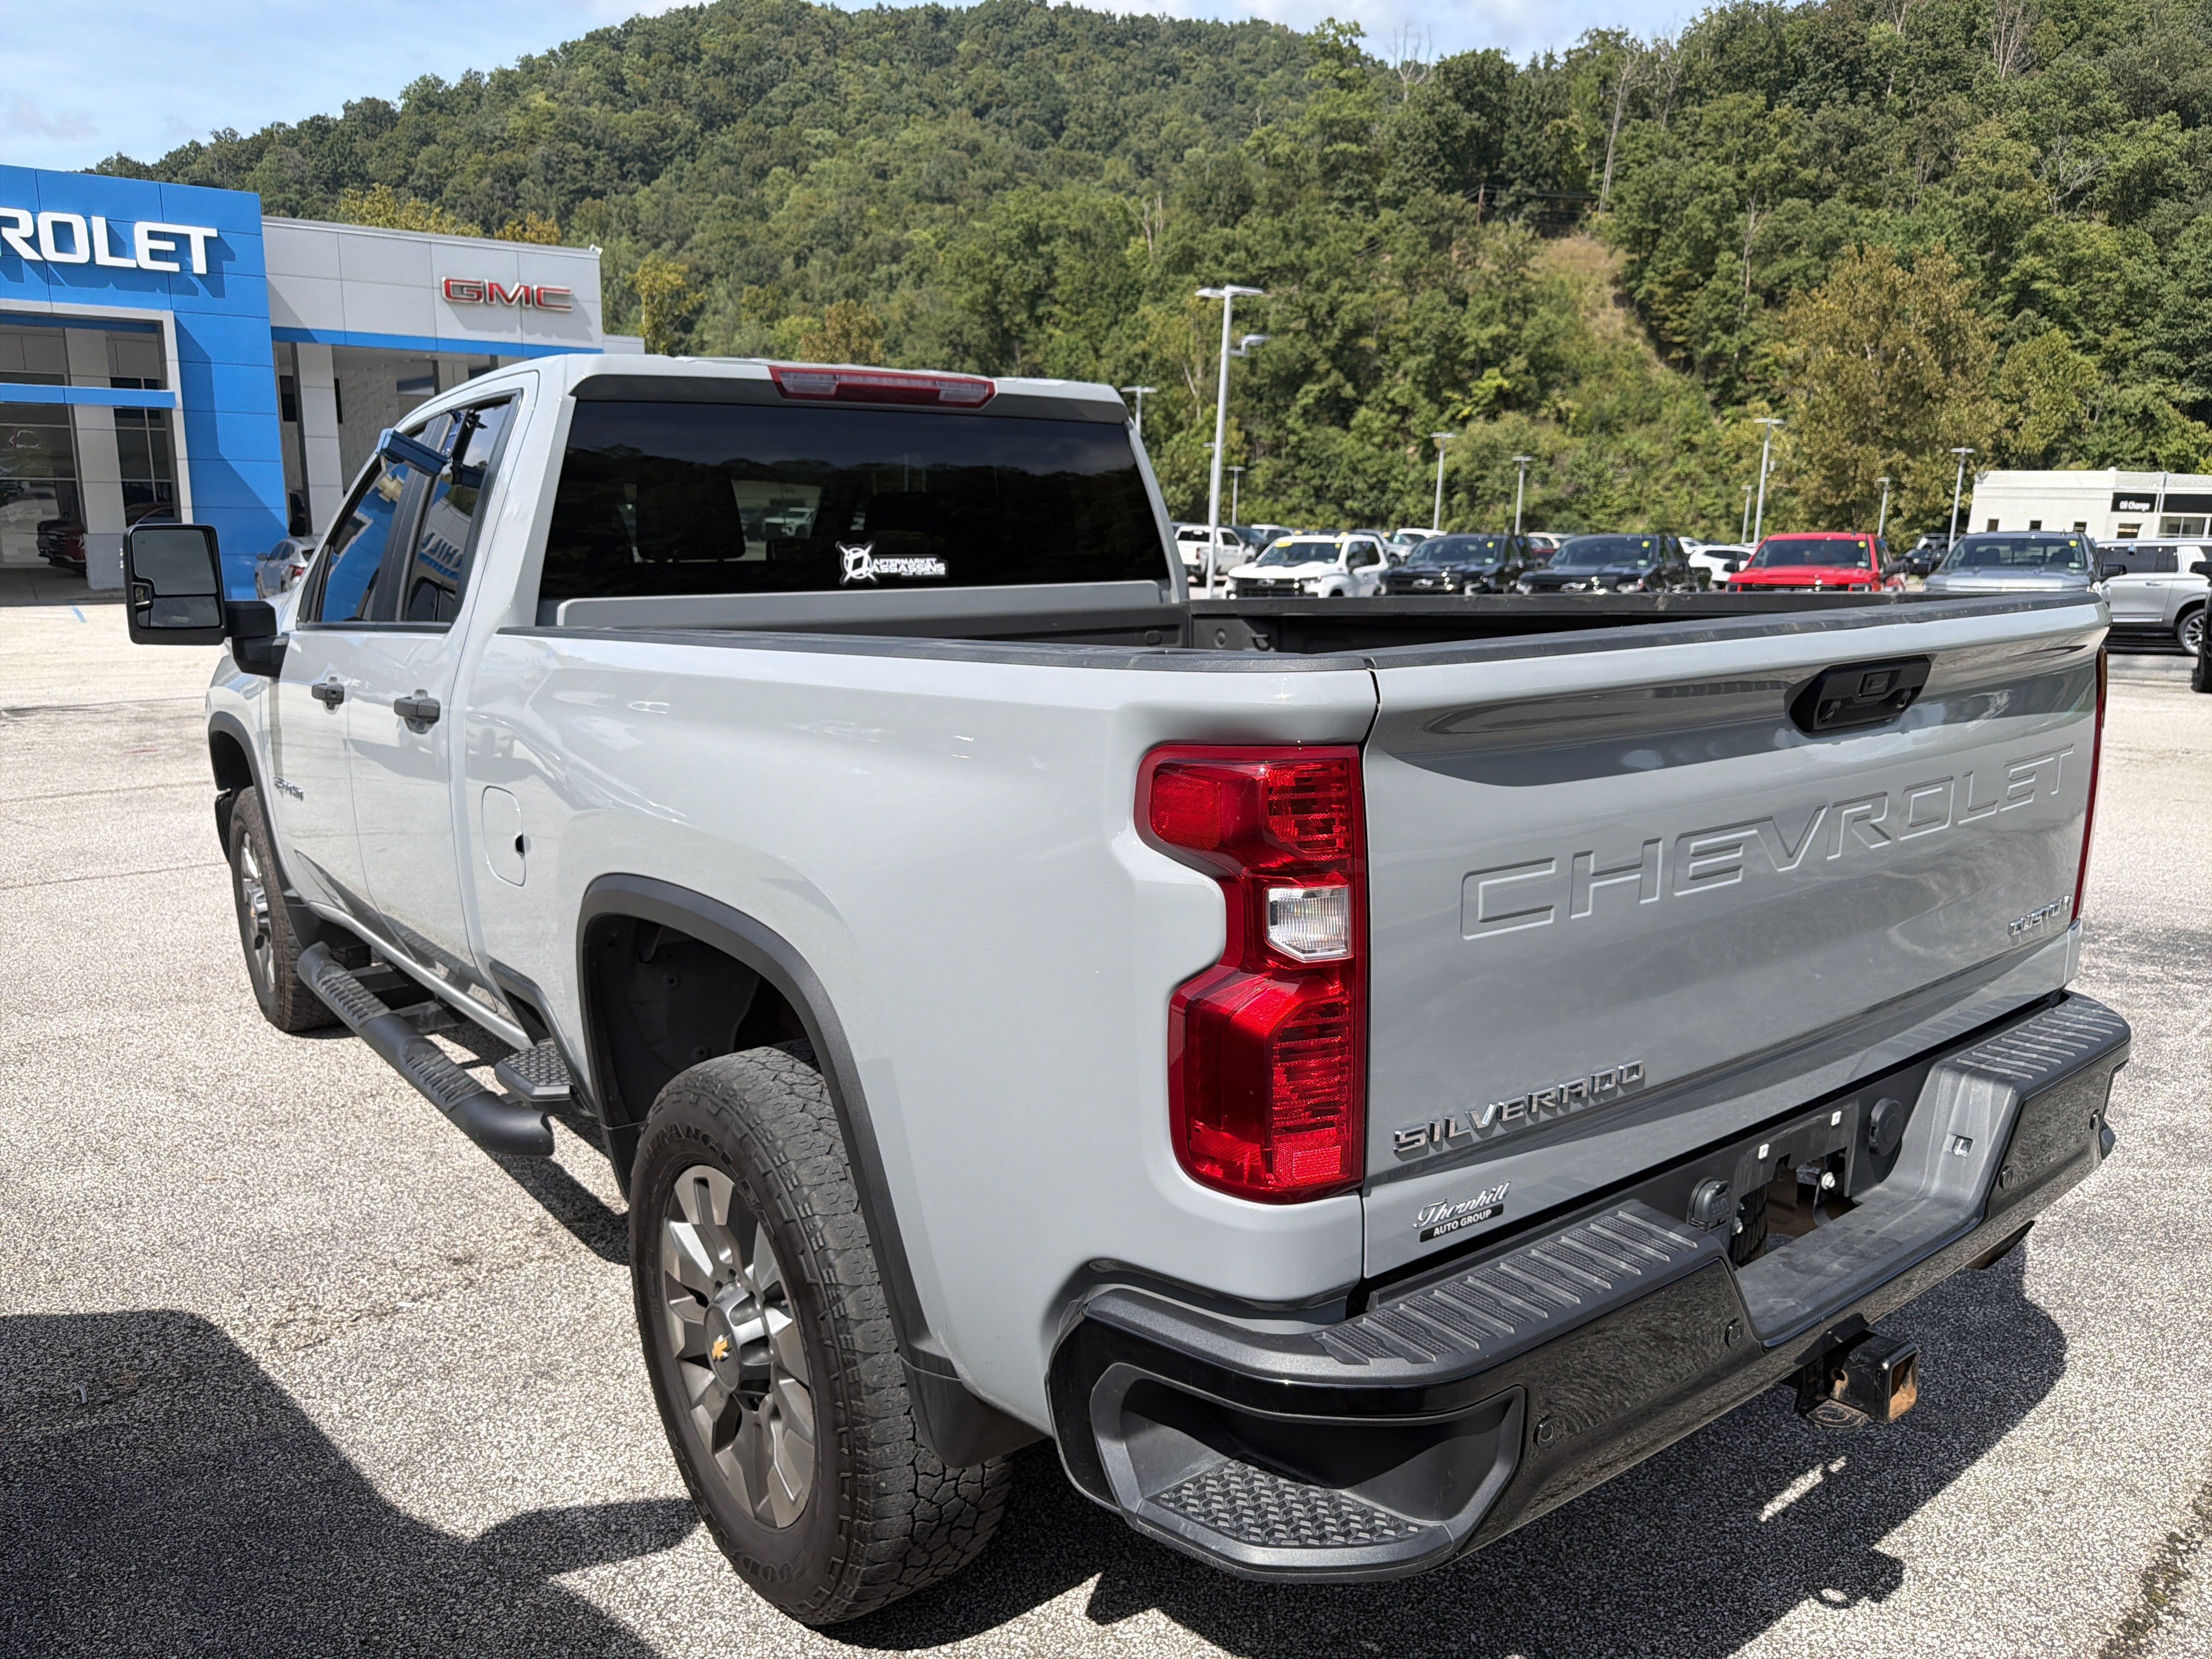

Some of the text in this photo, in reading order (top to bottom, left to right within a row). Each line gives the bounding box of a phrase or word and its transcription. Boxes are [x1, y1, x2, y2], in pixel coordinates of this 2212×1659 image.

[0, 207, 218, 274] ROLET
[441, 276, 573, 311] GMC
[871, 563, 945, 573] ASSASSINS
[1461, 743, 2074, 940] CHEVROLET
[1393, 1060, 1644, 1152] SILVERADO
[1413, 1181, 1511, 1229] Thornhill
[1433, 1209, 1492, 1237] AUTO GROUP
